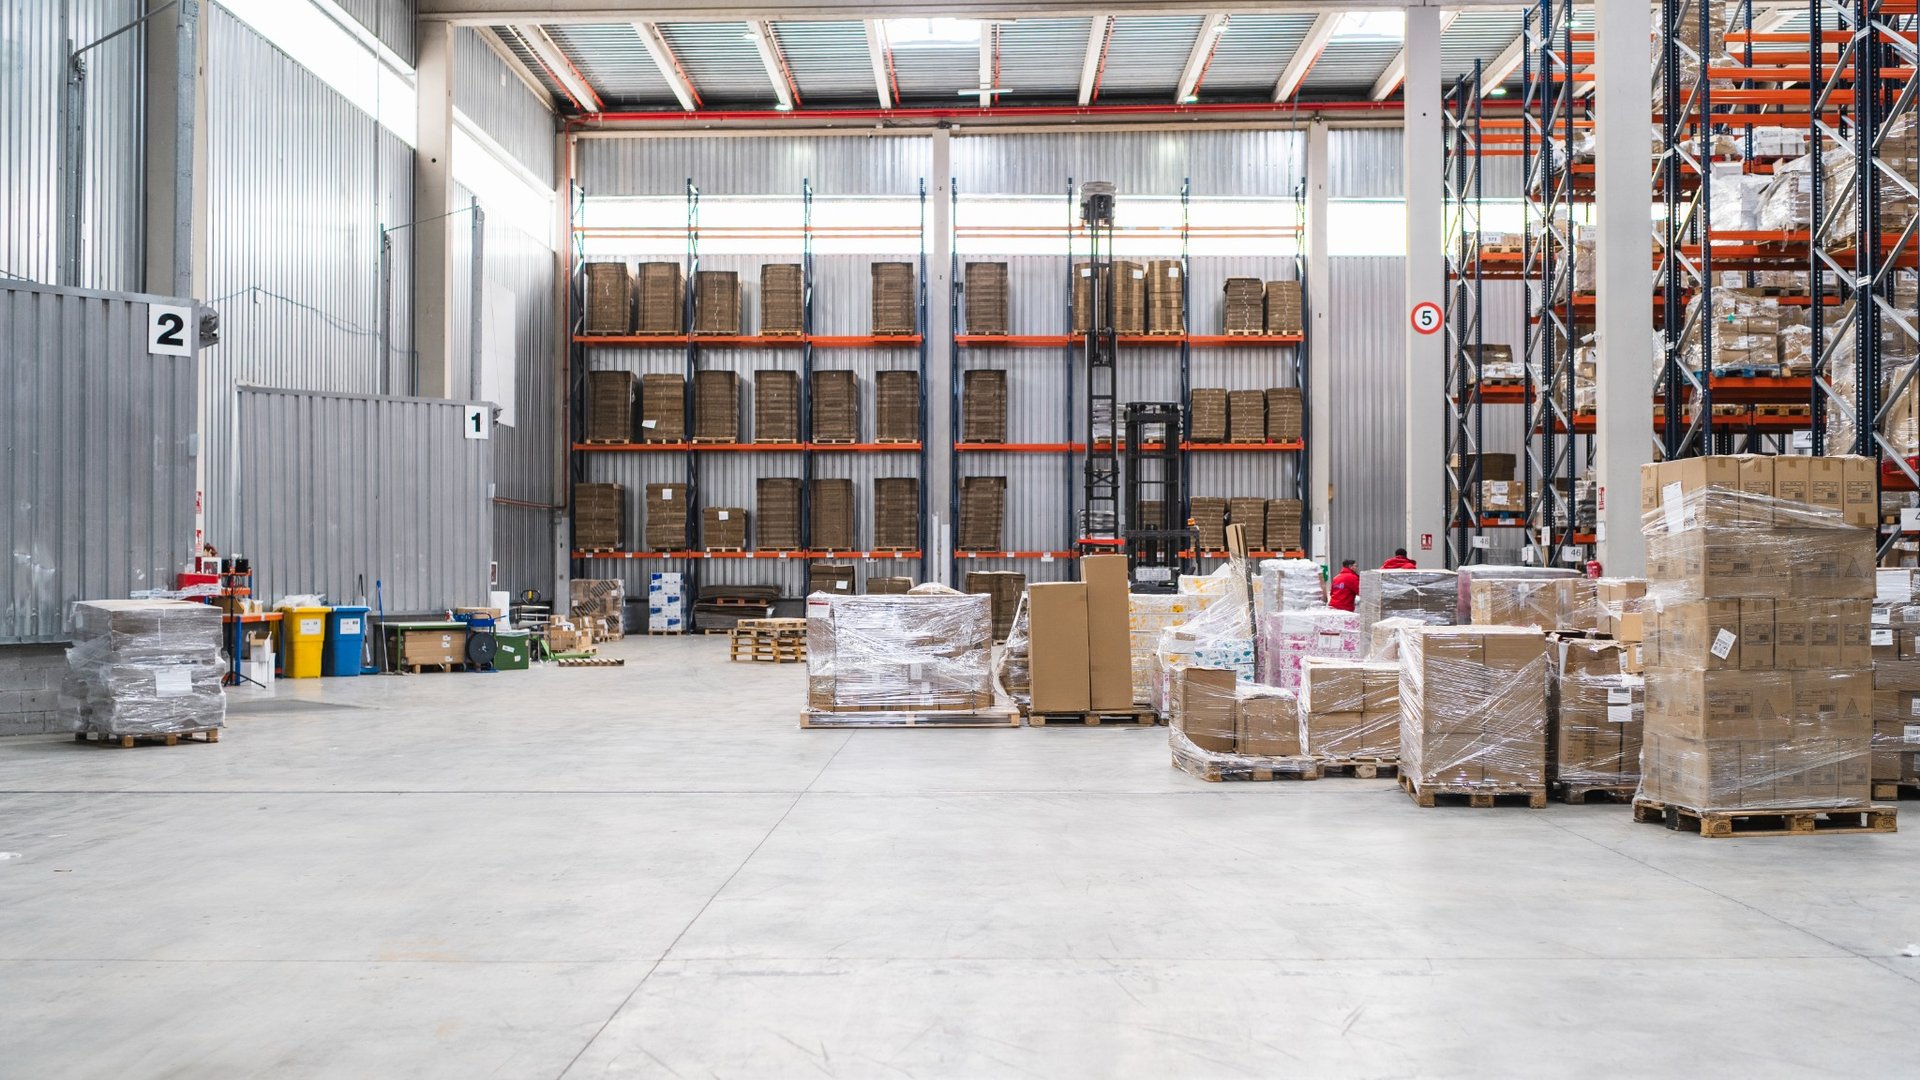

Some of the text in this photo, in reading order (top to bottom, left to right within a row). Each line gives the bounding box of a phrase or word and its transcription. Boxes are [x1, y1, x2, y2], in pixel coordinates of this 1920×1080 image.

[1422, 310, 1432, 326] 5
[156, 313, 184, 347] 2
[471, 412, 481, 432] 1
[1805, 432, 1812, 442] 4
[1571, 549, 1581, 557] 46
